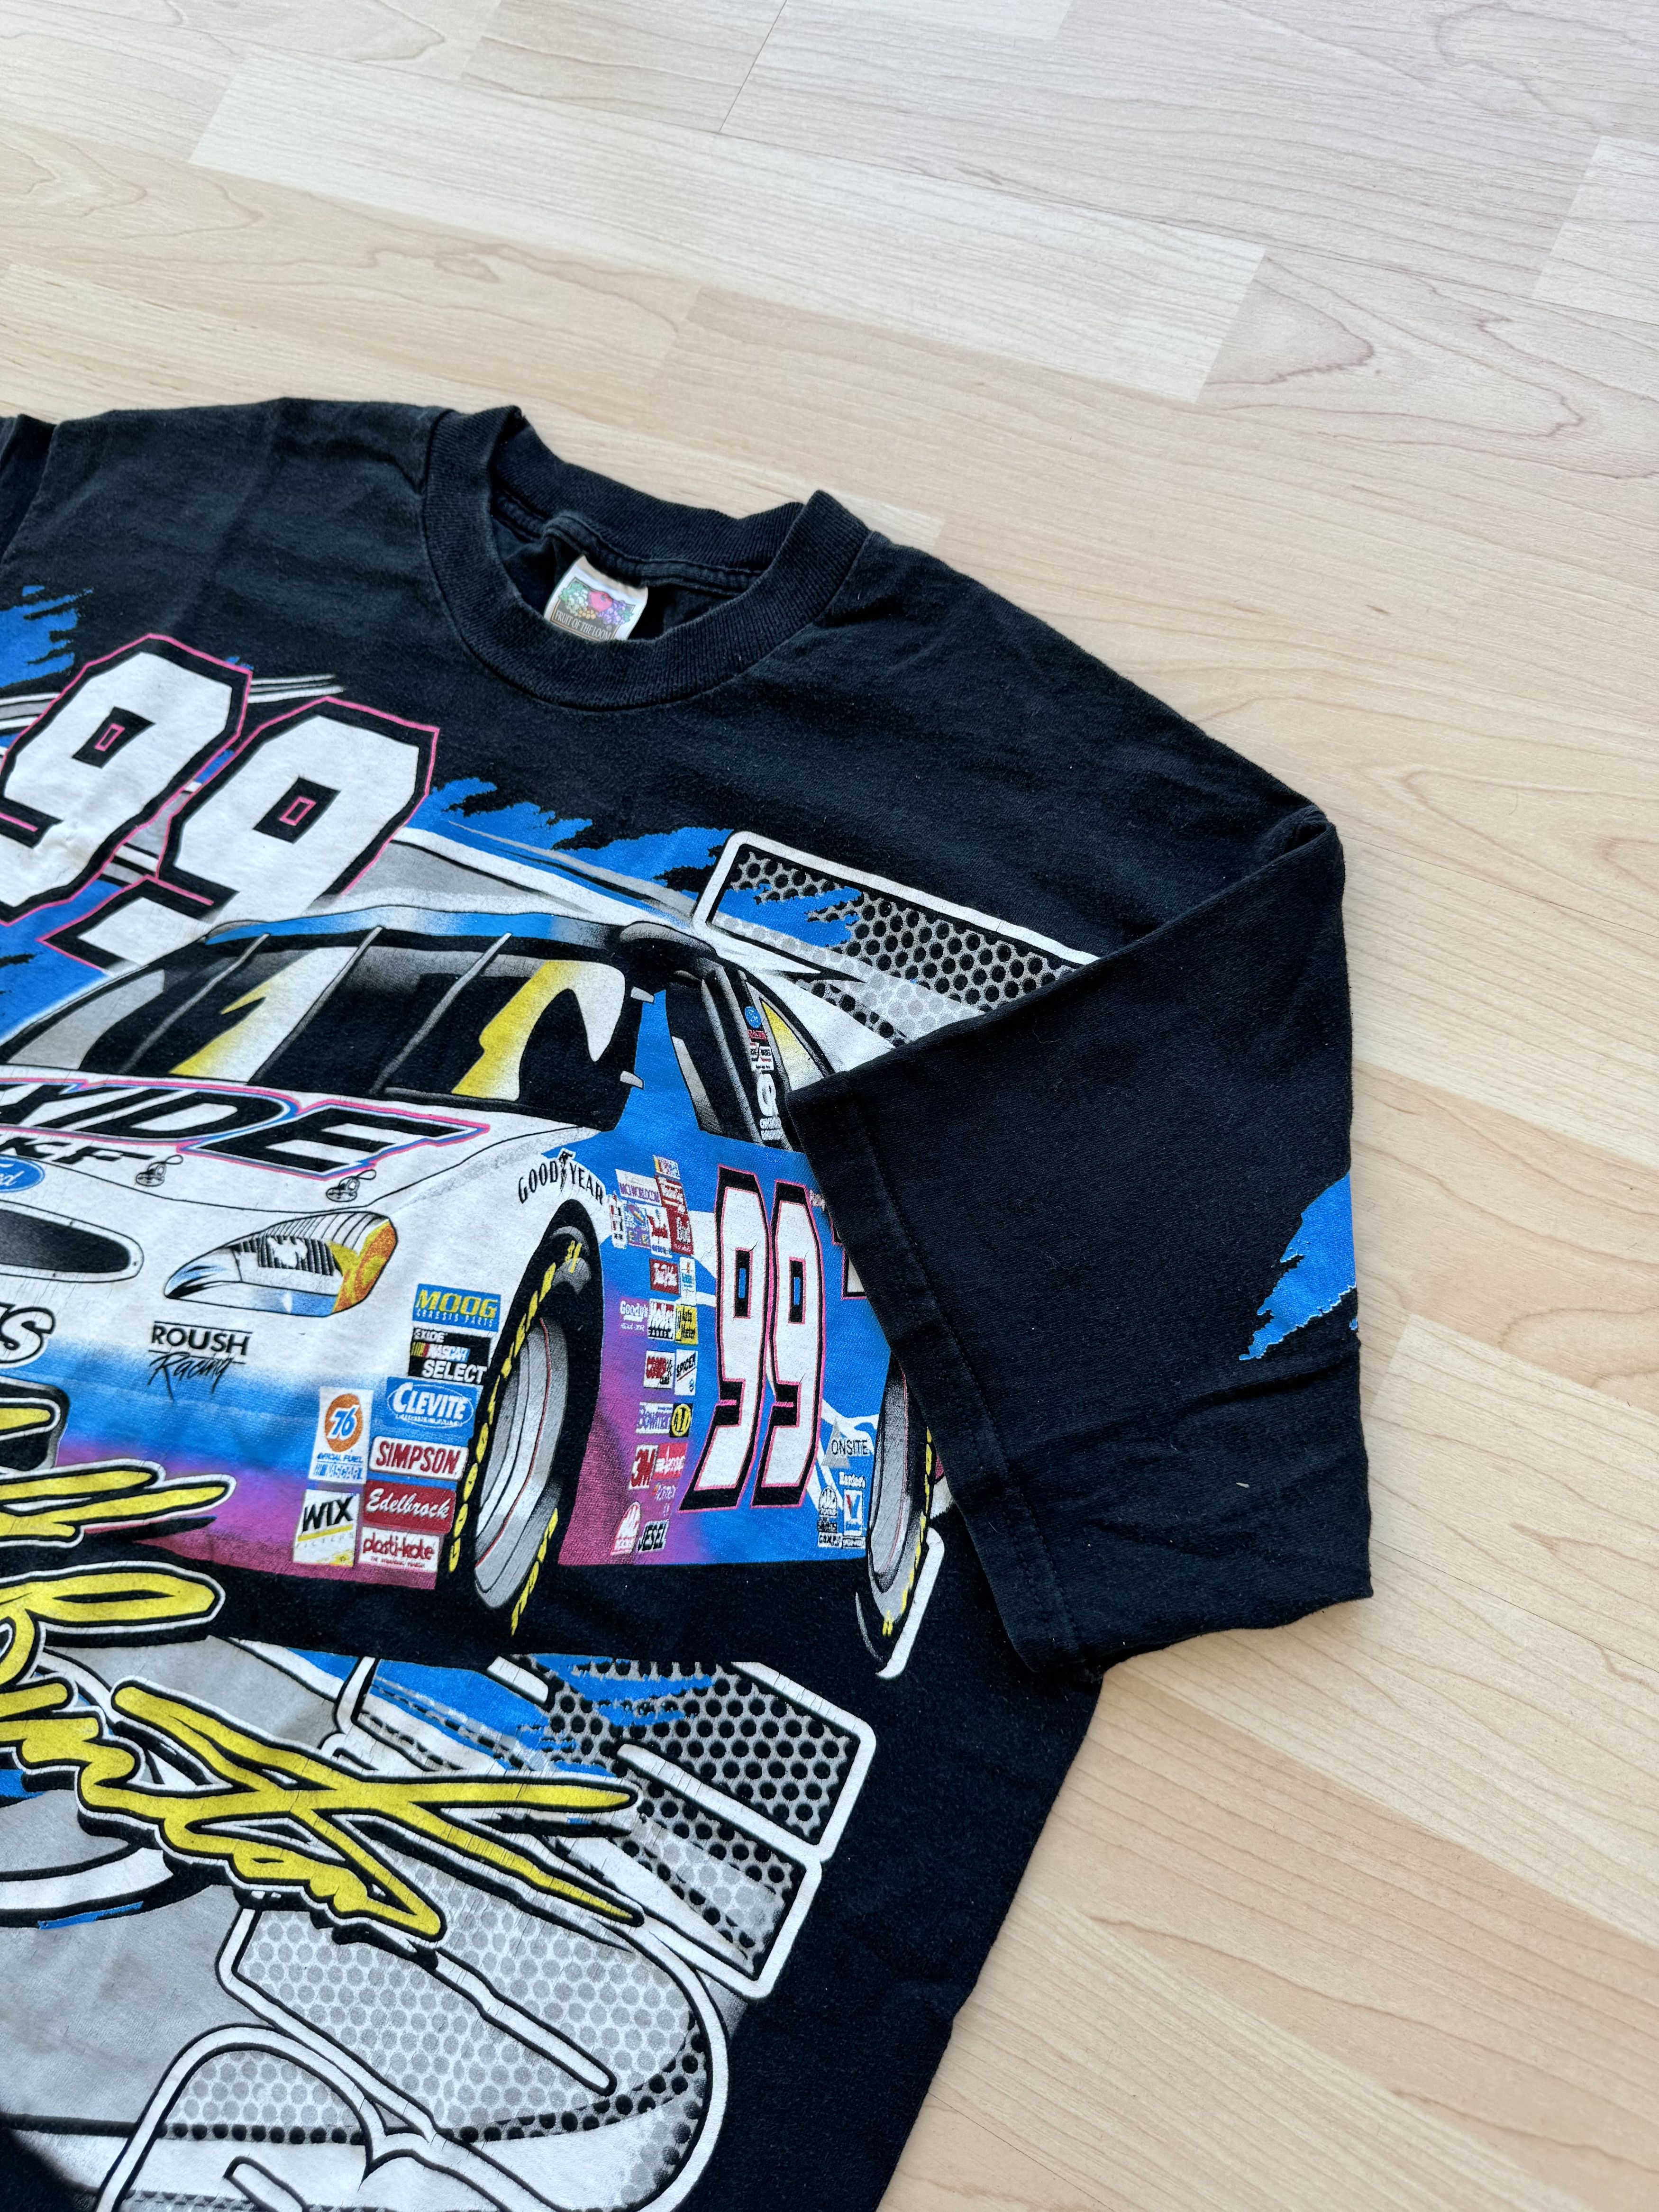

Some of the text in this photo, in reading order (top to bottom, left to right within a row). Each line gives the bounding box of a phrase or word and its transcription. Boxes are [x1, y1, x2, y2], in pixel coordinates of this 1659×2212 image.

[555, 611, 612, 640] FRUIT OF THE LOOM
[0, 640, 434, 972] 99
[0, 1081, 467, 1177] XIDE
[416, 1289, 498, 1319] MOOG
[413, 1328, 446, 1343] EXIDE
[464, 1314, 494, 1327] PARTS
[152, 1324, 250, 1356] ROUSH
[428, 1343, 470, 1363] NASCAR
[686, 1172, 822, 1503] 99
[147, 1351, 234, 1404] Racing
[421, 1359, 488, 1384] SELECT
[393, 1382, 466, 1420] CLEVITE
[327, 1404, 360, 1440] 76
[376, 1440, 461, 1475] SIMPSON
[831, 1439, 868, 1455] ONSITE
[631, 1448, 656, 1487] 3M
[302, 1495, 354, 1532] WIX
[365, 1488, 452, 1520] Edelbrock
[362, 1532, 435, 1560] plasti-kote
[638, 1522, 666, 1551] JESEL
